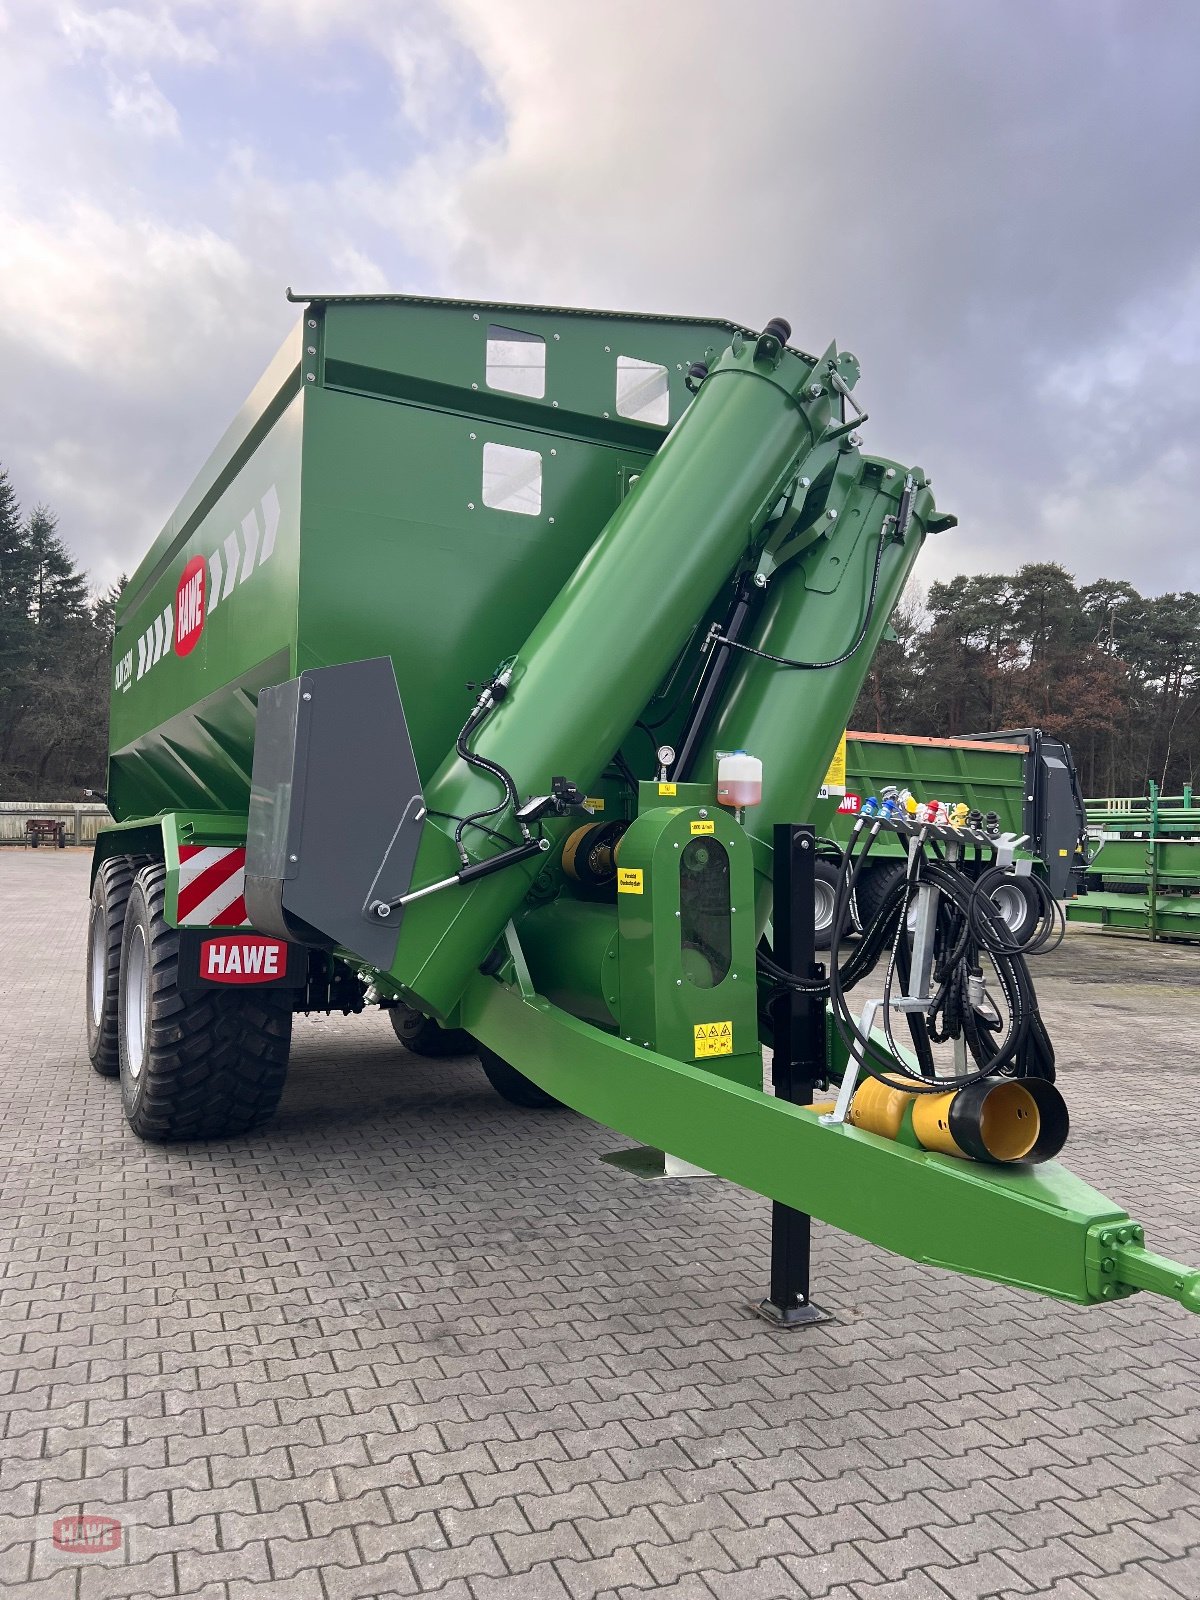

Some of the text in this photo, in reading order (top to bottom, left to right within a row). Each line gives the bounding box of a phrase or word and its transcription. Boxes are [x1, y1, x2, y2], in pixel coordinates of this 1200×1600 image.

[178, 568, 203, 643] HAWE
[838, 797, 858, 810] AWE
[208, 945, 279, 973] HAWE
